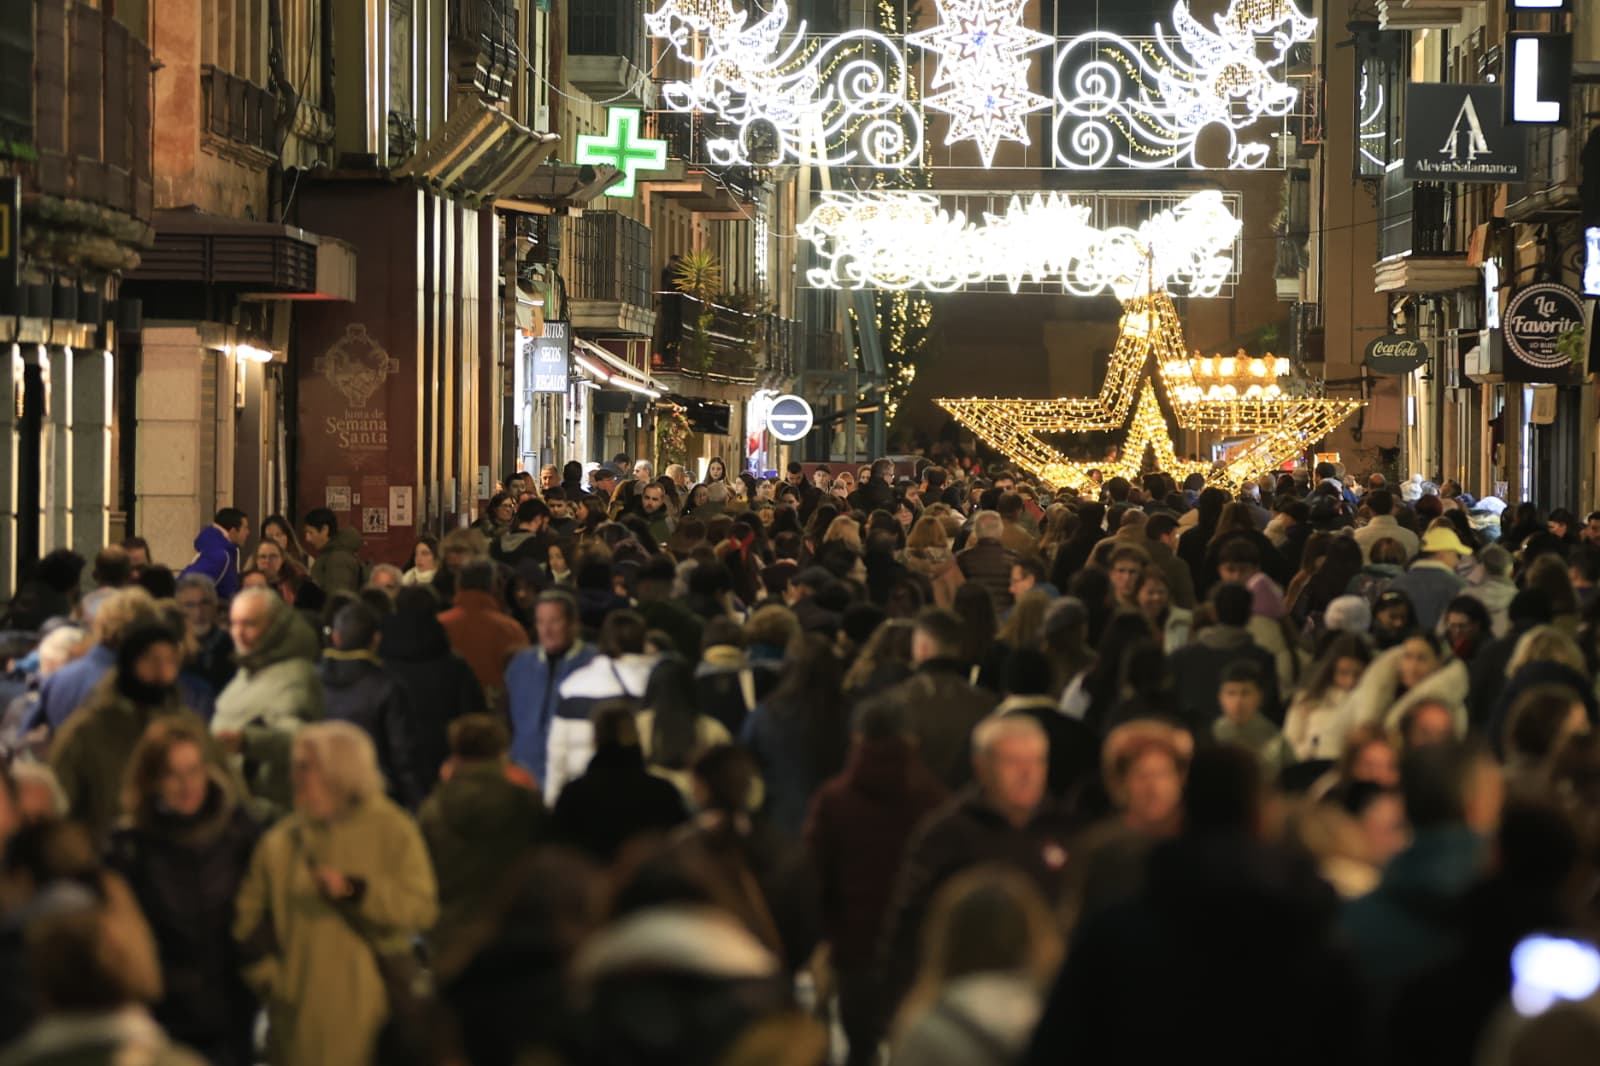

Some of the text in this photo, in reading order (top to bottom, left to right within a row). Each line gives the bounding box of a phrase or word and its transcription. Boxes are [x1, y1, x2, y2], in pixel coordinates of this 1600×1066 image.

[1513, 0, 1562, 121] L
[1535, 296, 1557, 317] La
[543, 323, 564, 338] RUTOS
[540, 346, 561, 362] SECOS
[371, 408, 385, 419] de
[326, 416, 388, 434] Semana
[339, 431, 388, 449] Santa
